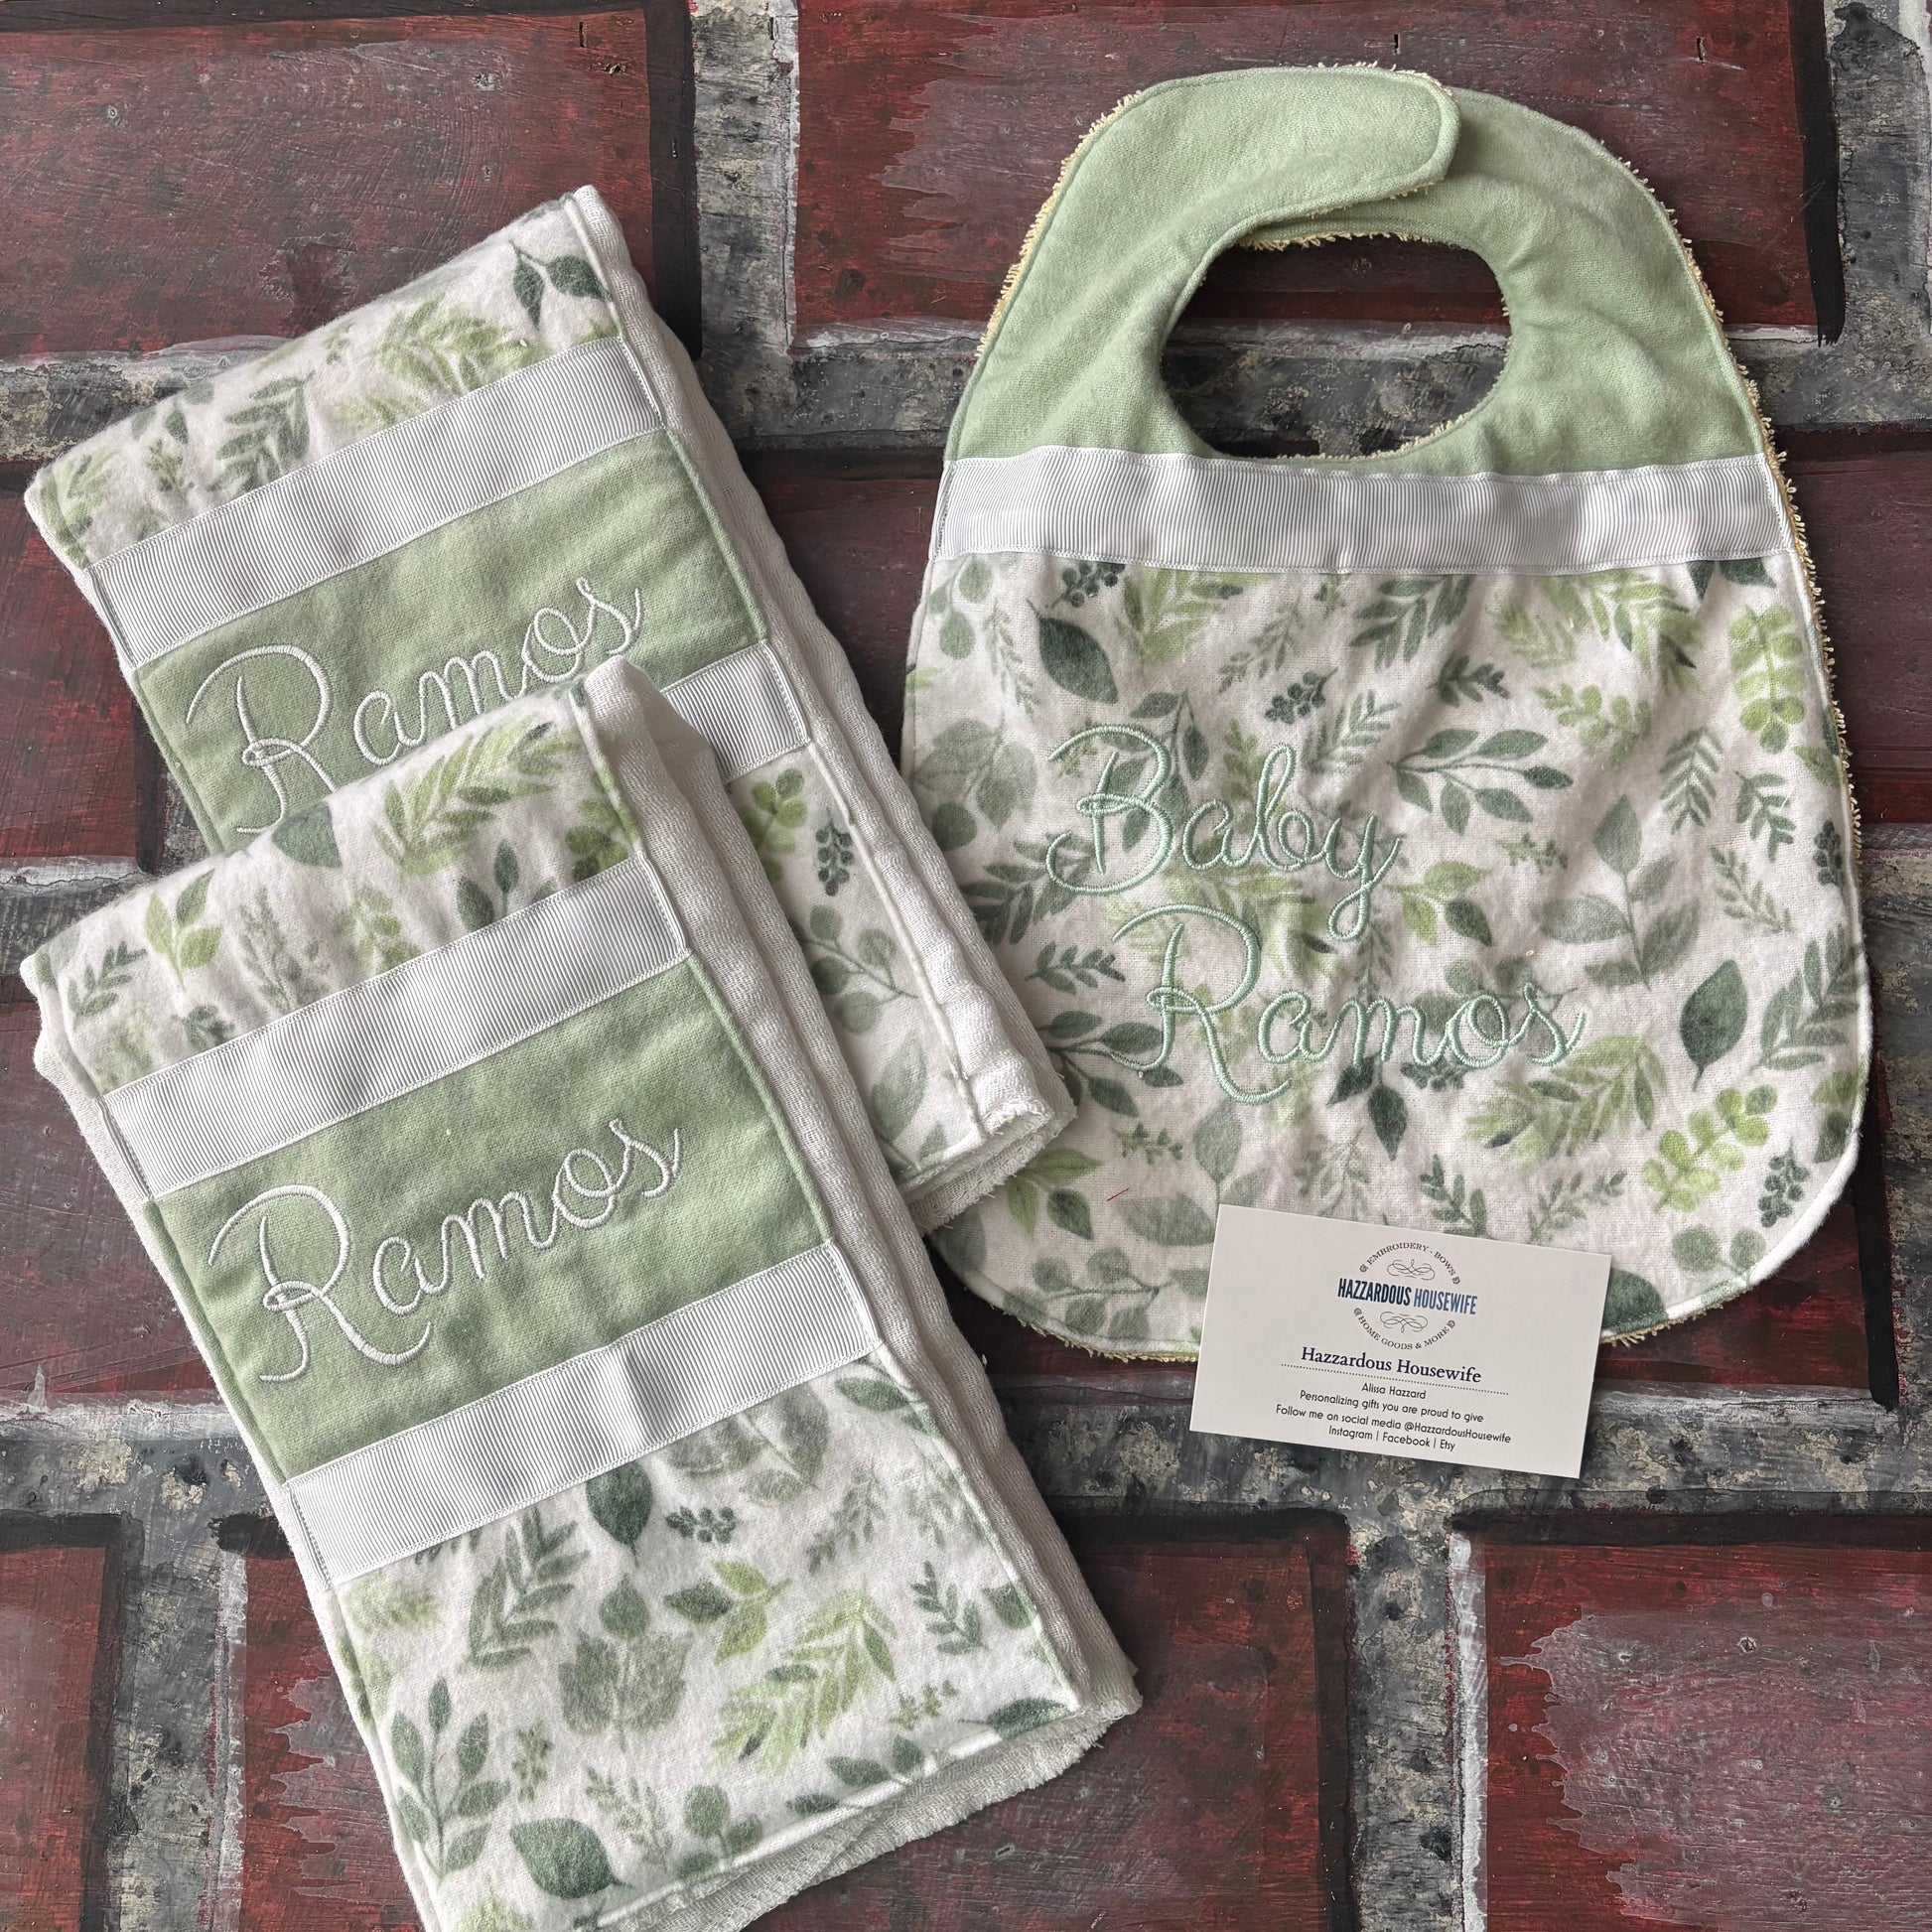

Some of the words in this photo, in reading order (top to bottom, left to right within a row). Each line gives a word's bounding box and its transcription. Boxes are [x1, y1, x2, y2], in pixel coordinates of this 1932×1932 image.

[186, 577, 643, 834] Ramos
[1045, 724, 1403, 941] Baby
[1109, 903, 1587, 1104] Ramos
[207, 1118, 682, 1383] Ramos
[1367, 1242, 1430, 1266] EMBROIDERY
[1434, 1251, 1456, 1277] BOWS
[1337, 1278, 1412, 1307] HAZZARDOUS
[1413, 1288, 1478, 1315] HOUSEWIFE
[1357, 1314, 1381, 1341] HOME
[1381, 1338, 1413, 1350] GOODS
[1415, 1341, 1423, 1350] &
[1424, 1325, 1450, 1347] MORE
[1301, 1346, 1392, 1371] Hazzardous
[1397, 1359, 1481, 1383] Housewife
[1300, 1390, 1358, 1409] Personalizing
[1361, 1399, 1379, 1410] gifts
[1382, 1403, 1399, 1412] you
[1421, 1408, 1449, 1418] proud
[1451, 1411, 1460, 1420] to
[1464, 1413, 1484, 1423] give
[1361, 1382, 1385, 1394] Alissa
[1389, 1386, 1426, 1399] Hazzard
[1276, 1404, 1307, 1417] Follow
[1342, 1415, 1368, 1425] social
[1371, 1418, 1402, 1430] media
[1404, 1422, 1511, 1444] @HazzardousHousewife
[1328, 1425, 1372, 1440] Instagram
[1382, 1432, 1430, 1448] Facebook
[1440, 1439, 1455, 1451] Etsy
